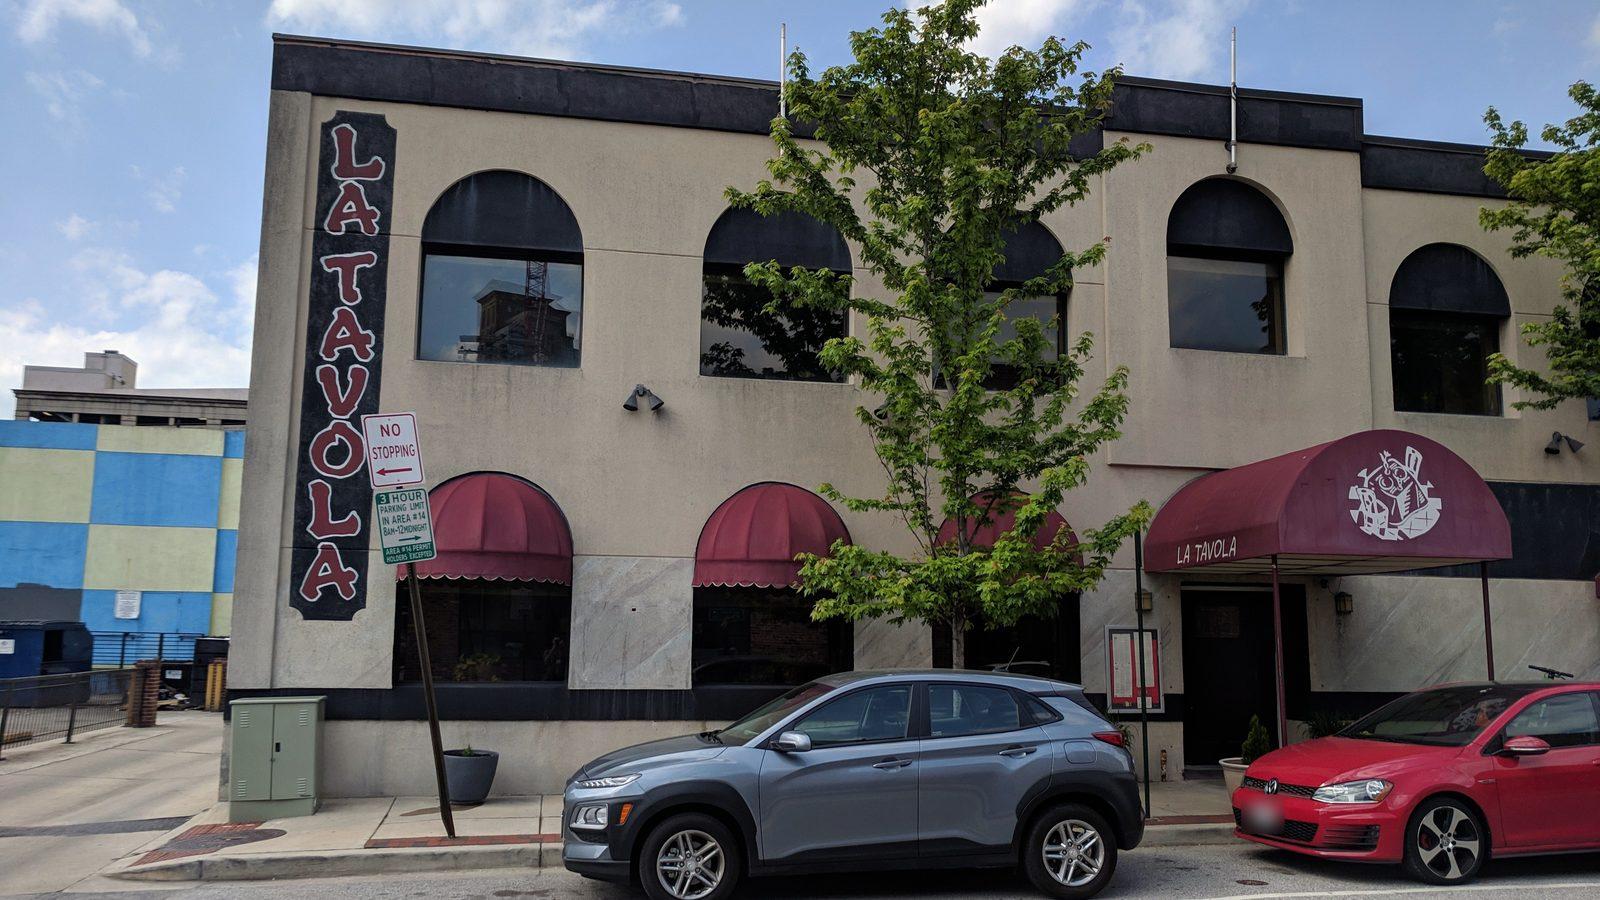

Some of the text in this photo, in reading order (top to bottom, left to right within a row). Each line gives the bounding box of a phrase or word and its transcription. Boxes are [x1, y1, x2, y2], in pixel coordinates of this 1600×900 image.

[300, 123, 385, 601] LA TAVOLA
[380, 423, 401, 437] NO
[372, 443, 416, 460] STOPPING
[380, 491, 422, 504] 3 HOUR
[380, 501, 425, 514] PARKING LIMIT
[382, 516, 389, 526] IN
[392, 513, 411, 524] AREA
[385, 547, 400, 556] AREA
[412, 542, 431, 552] PERMIT
[1177, 536, 1237, 565] LA TAVOLA
[386, 550, 433, 563] HOLDERS EXCEPTED
